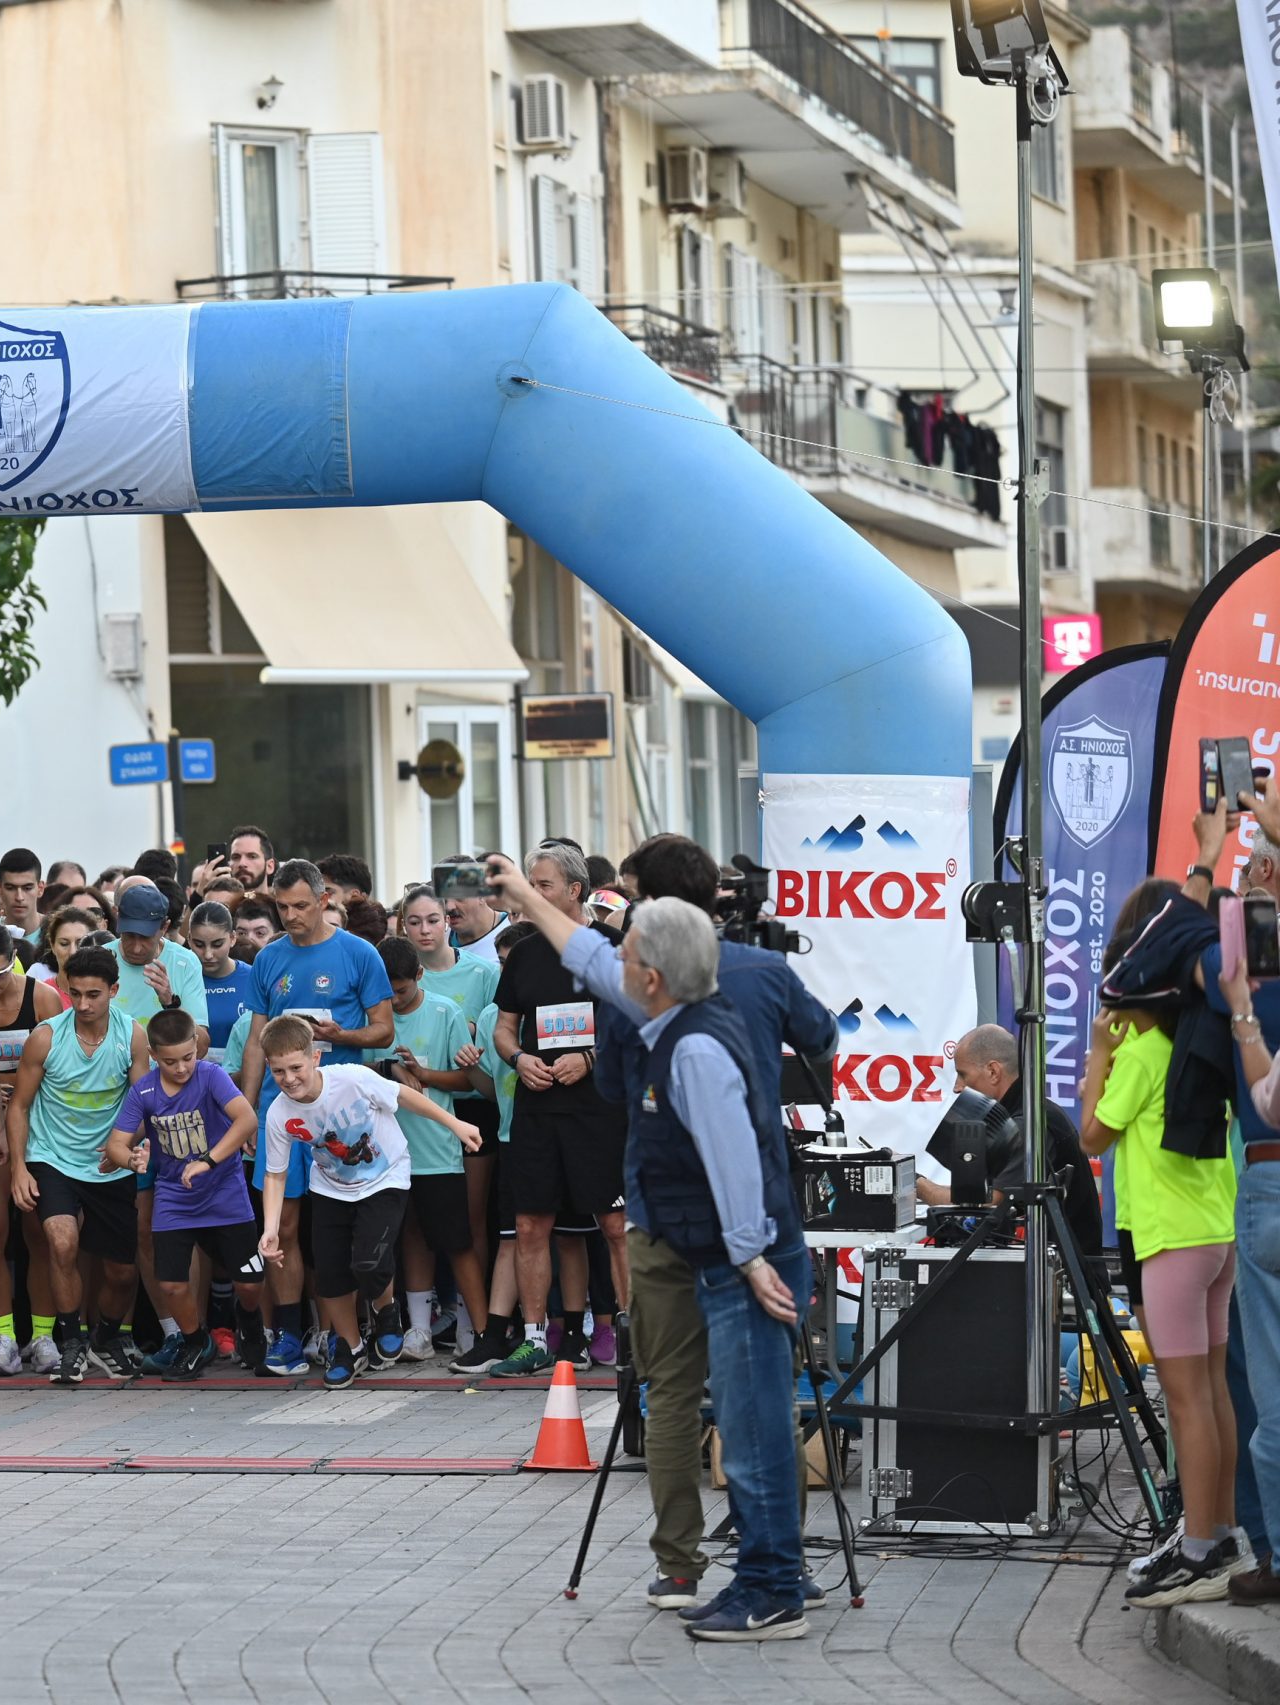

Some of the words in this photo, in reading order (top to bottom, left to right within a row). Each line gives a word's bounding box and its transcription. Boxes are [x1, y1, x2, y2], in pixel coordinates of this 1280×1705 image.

[1053, 621, 1092, 665] T
[1081, 740, 1125, 755] ΗΝΙΟΧΟΣ
[1075, 821, 1099, 832] 2020
[775, 870, 946, 921] ΒΙΚΟΣ
[1089, 871, 1106, 927] 2020
[1089, 933, 1103, 974] est.
[1044, 868, 1085, 1109] ΗΝΙΟΧΟΣ
[543, 1016, 587, 1034] 5056
[150, 1109, 205, 1133] STEREA
[157, 1124, 208, 1160] RUN
